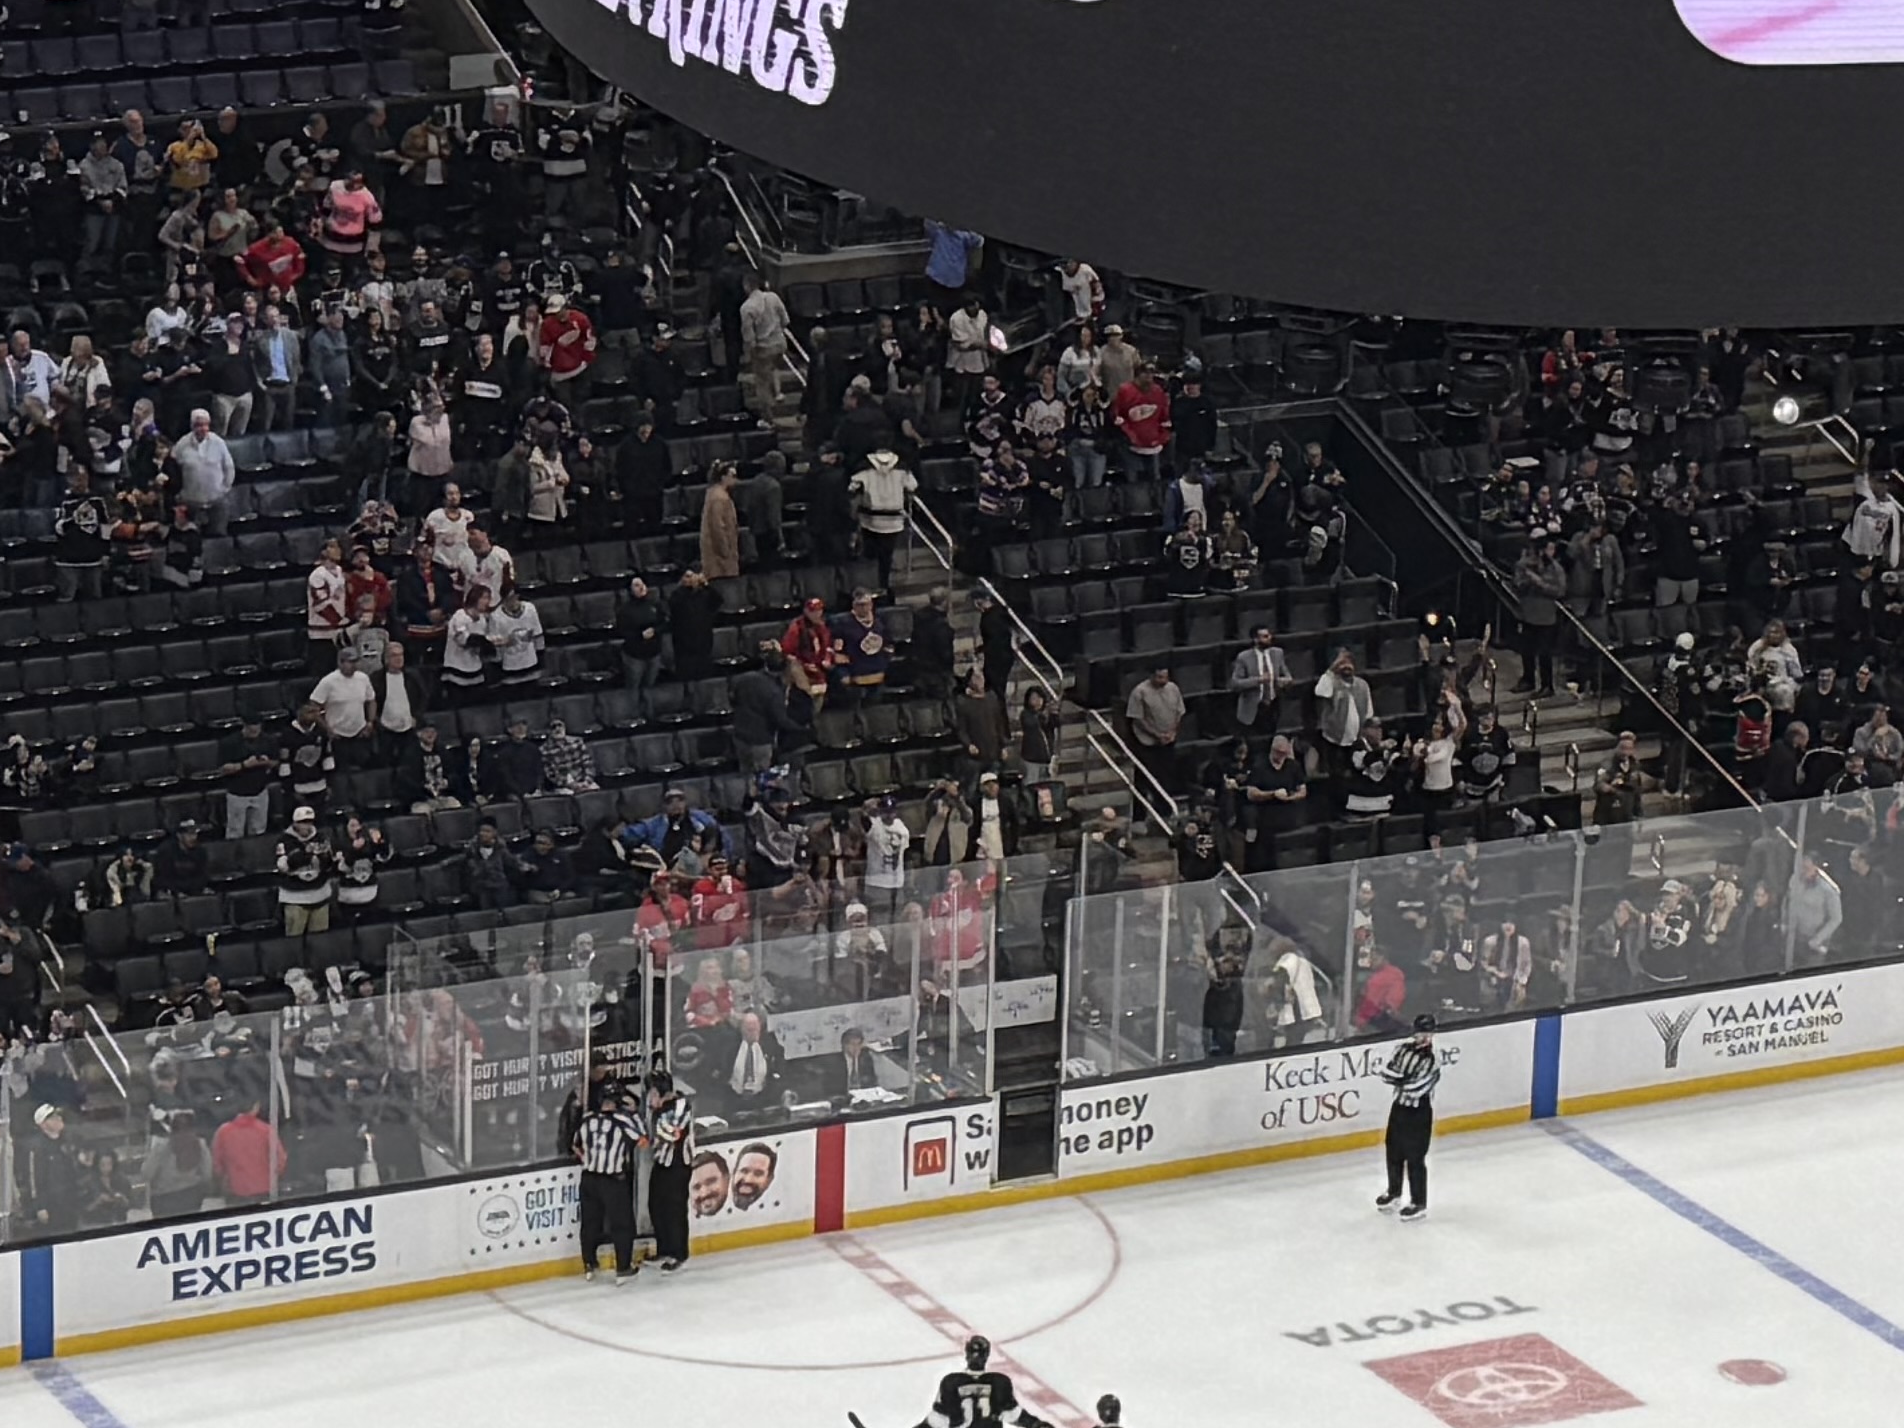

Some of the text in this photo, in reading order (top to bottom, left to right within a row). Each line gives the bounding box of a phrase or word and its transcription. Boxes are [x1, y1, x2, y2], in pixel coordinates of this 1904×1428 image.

[1703, 1011, 1844, 1047] RESORT & CASINO
[1727, 1041, 1762, 1058] SAN
[1764, 1032, 1829, 1052] MANUEL
[1264, 1056, 1330, 1092] Keck
[1260, 1090, 1361, 1132] of USC
[1098, 1124, 1154, 1155] app
[525, 1187, 557, 1211] GOT
[136, 1203, 373, 1270] AMERICAN
[525, 1207, 566, 1233] VISIT
[171, 1240, 378, 1302] EXPRESS
[1280, 1294, 1540, 1347] TOYOTA
